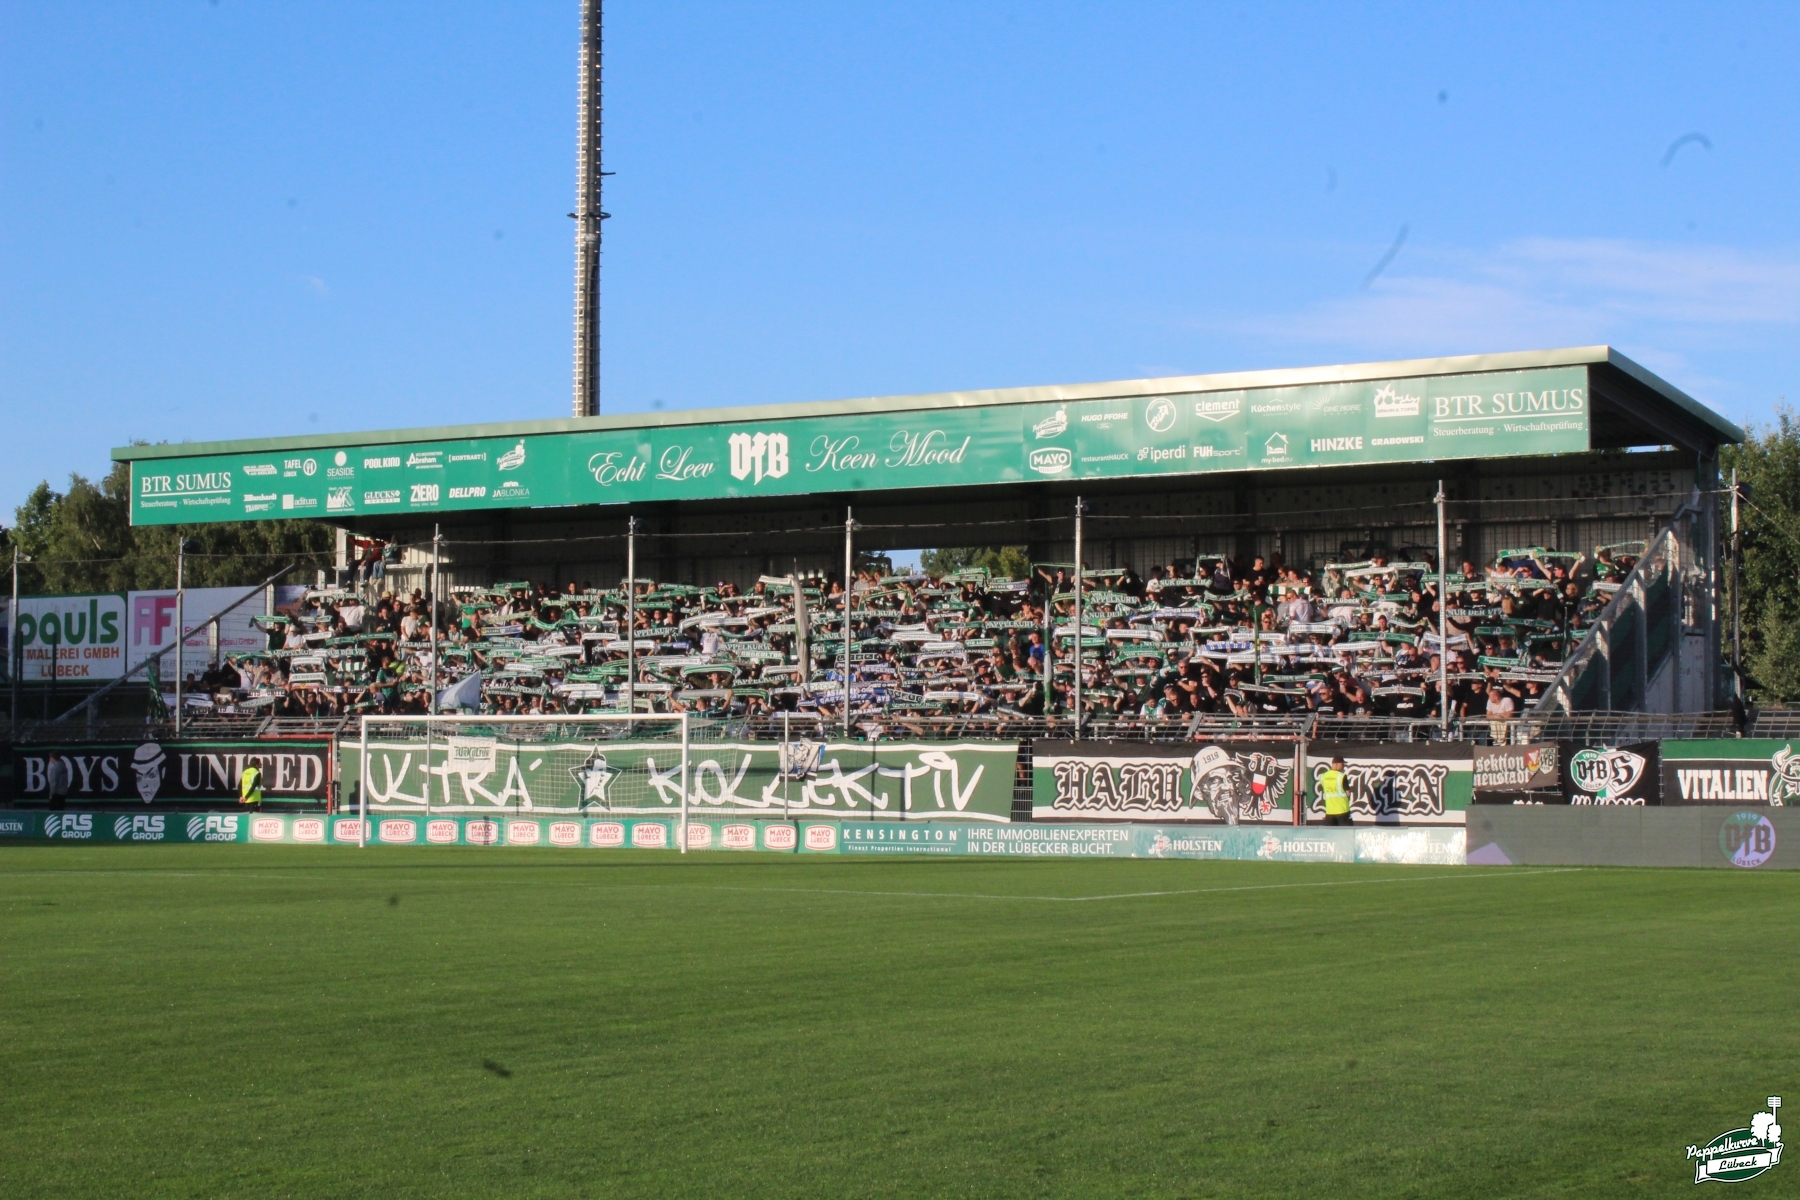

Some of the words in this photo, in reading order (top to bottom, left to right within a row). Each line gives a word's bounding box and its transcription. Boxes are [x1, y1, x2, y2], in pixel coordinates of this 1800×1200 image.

[1195, 399, 1240, 411] clement
[1251, 402, 1301, 413] Küchenstyle
[1434, 395, 1484, 417] BTR
[1492, 388, 1583, 414] SUMUS
[1103, 412, 1129, 420] PFOHE
[1434, 426, 1494, 437] Steuerberatung
[1503, 421, 1583, 432] Wirtschaftsprüfung
[1311, 437, 1363, 452] HINZKE
[1371, 436, 1424, 446] GRABOWSKI
[805, 435, 879, 472] Keen
[885, 430, 972, 467] Mood
[1151, 445, 1185, 463] iperdi
[284, 459, 301, 469] TAFEL
[1034, 453, 1067, 465] MAYO
[327, 467, 354, 477] SEASIDE
[588, 452, 646, 487] Echt
[655, 445, 716, 481] Leev
[141, 476, 172, 493] BTR
[176, 472, 232, 491] SUMUS
[449, 486, 486, 498] DELLPRO
[140, 500, 178, 508] Steuerberatung
[182, 497, 231, 506] Wirtschaftsprüfung
[27, 648, 79, 660] MALEREI
[83, 647, 119, 659] GMBH
[41, 663, 90, 677] LÜBECK
[1203, 751, 1220, 764] 1919
[1476, 752, 1525, 773] sektion
[1677, 769, 1768, 800] VITALIEN
[62, 814, 93, 830] FLS
[1736, 813, 1758, 821] 1919
[132, 815, 165, 832] FLS
[205, 816, 238, 832] FLS
[62, 831, 92, 839] GROUP
[132, 832, 165, 840] GROUP
[638, 826, 661, 834] MAYO
[688, 827, 706, 835] AYO
[727, 828, 750, 836] MAYO
[770, 829, 790, 837] MAYO
[843, 829, 957, 841] KENSINGTON
[967, 828, 993, 840] IHRE
[997, 829, 1129, 841] IMMOBILIENEXPERTEN
[205, 833, 237, 841] GROUP
[967, 842, 979, 853] IN
[983, 842, 1005, 853] DER
[1009, 840, 1068, 854] LÜBECKER
[1072, 843, 1114, 855] BUCHT.
[1173, 840, 1223, 851] HOLSTEN
[1283, 842, 1335, 853] HOLSTEN
[1732, 857, 1762, 867] LÜBECK
